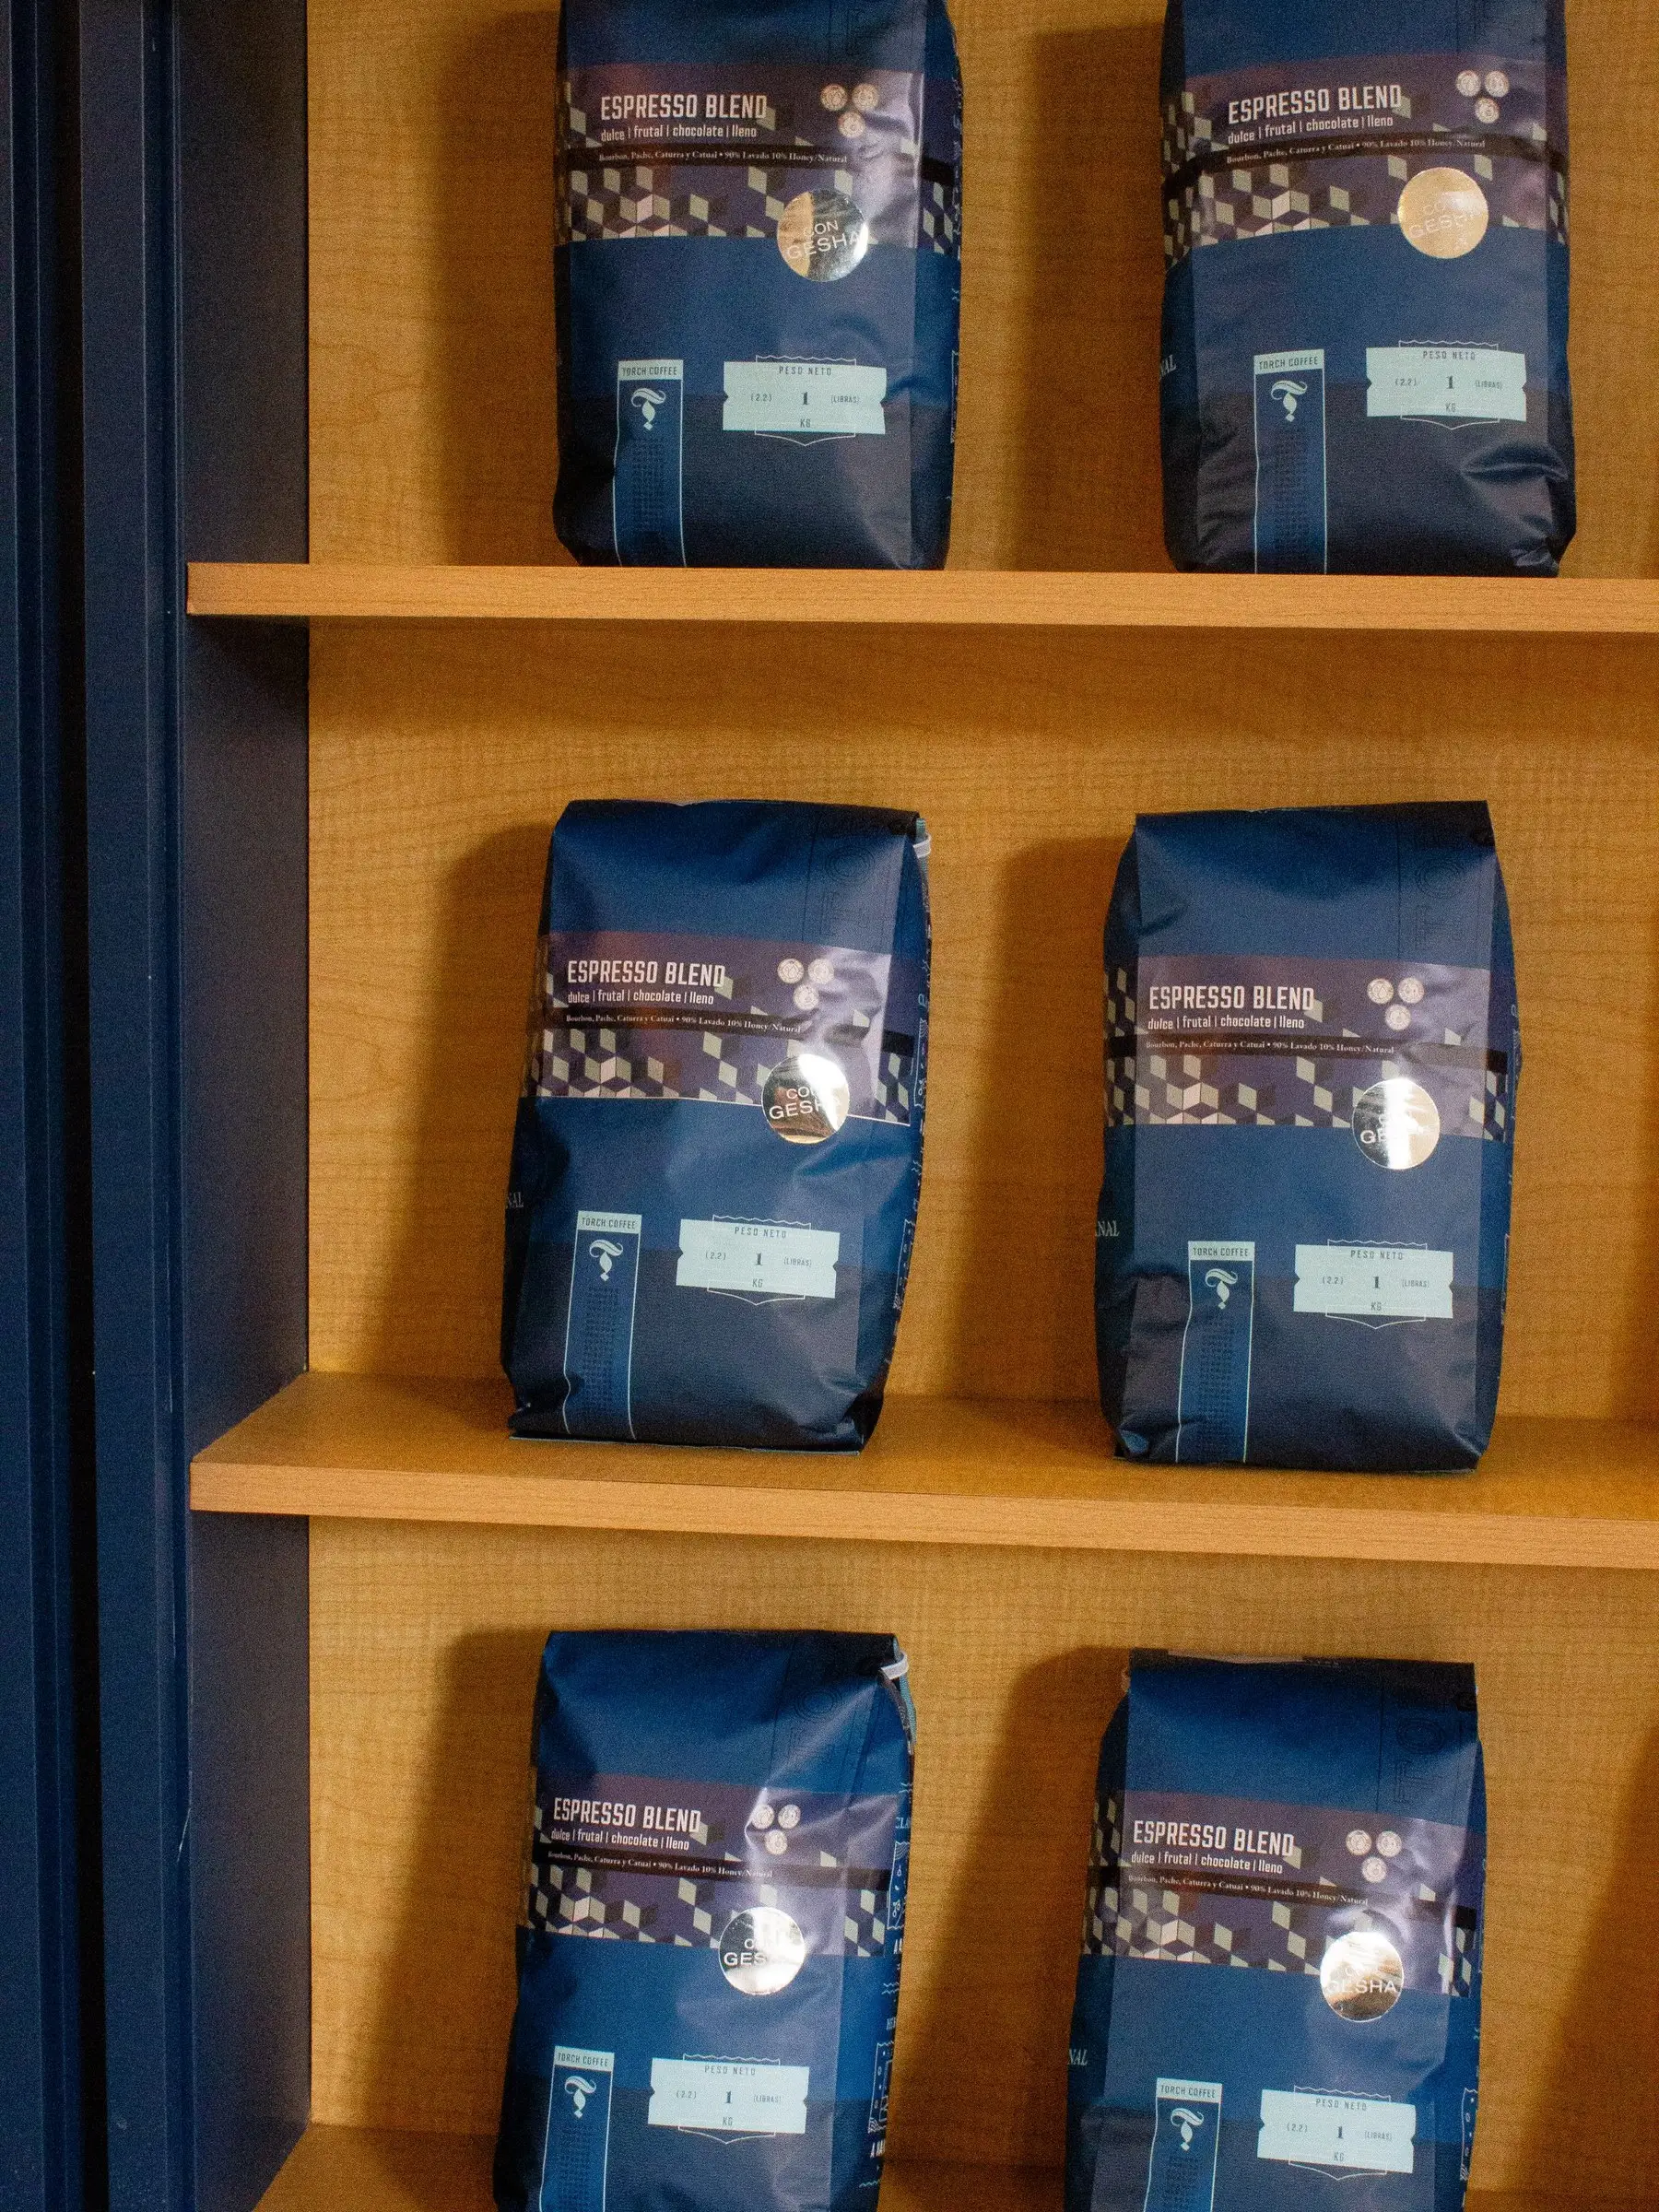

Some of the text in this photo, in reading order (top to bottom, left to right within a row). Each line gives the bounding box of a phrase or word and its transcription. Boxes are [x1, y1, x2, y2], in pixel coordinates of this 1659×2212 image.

[601, 94, 768, 120] ESPRESSO BLEND
[1228, 85, 1402, 124] ESPRESSO BLEND
[601, 124, 757, 142] dulce frutal chocolate lleno
[1228, 115, 1394, 145] dulce frutal chocolate lleno
[742, 151, 770, 159] Lavado
[803, 219, 839, 238] CON
[784, 229, 861, 260] GESHA
[1423, 351, 1476, 360] PESO NETO
[1259, 356, 1318, 370] TORCH COFFEE
[622, 366, 677, 376] TORCH COFFEE
[779, 366, 832, 376] PESO NETO
[1446, 376, 1454, 390] 1
[801, 392, 808, 406] 1
[1446, 403, 1456, 413] KG
[800, 418, 811, 428] KG
[567, 960, 725, 987] ESPRESSO BLEND
[568, 989, 713, 1005] dulce frutal chocolate lleno
[1149, 985, 1314, 1011] ESPRESSO BLEND
[699, 1018, 725, 1026] Lavado
[1147, 1015, 1304, 1030] dulce frutal chocolate lleno
[1290, 1042, 1317, 1051] Lavado
[582, 1218, 636, 1230] TORCH COFFEE
[734, 1226, 787, 1239] PESO NETO
[1193, 1247, 1249, 1257] TORCH COFFEE
[1350, 1250, 1404, 1260] PESO NETO
[755, 1253, 762, 1265] 1
[752, 1279, 763, 1288] KG
[1372, 1276, 1380, 1288] 1
[1371, 1301, 1382, 1311] KG
[553, 1797, 701, 1833] ESPRESSO BLEND
[551, 1830, 689, 1851] dulce frutal chocolate lleno
[1134, 1820, 1294, 1856] ESPRESSO BLEND
[674, 1863, 700, 1872] Lavado
[1131, 1852, 1283, 1875] dulce frutal chocolate lleno
[1267, 1886, 1293, 1896] Lavado
[723, 1951, 768, 1967] GES
[558, 2052, 608, 2067] TORCH COFFEE
[704, 2065, 756, 2076] PESO NETO
[725, 2091, 732, 2104] 1
[1160, 2085, 1216, 2098] TORCH COFFEE
[1315, 2098, 1367, 2112] PESO NETO
[722, 2117, 733, 2126] KG
[1336, 2125, 1344, 2139] 1
[1334, 2152, 1345, 2161] KG
